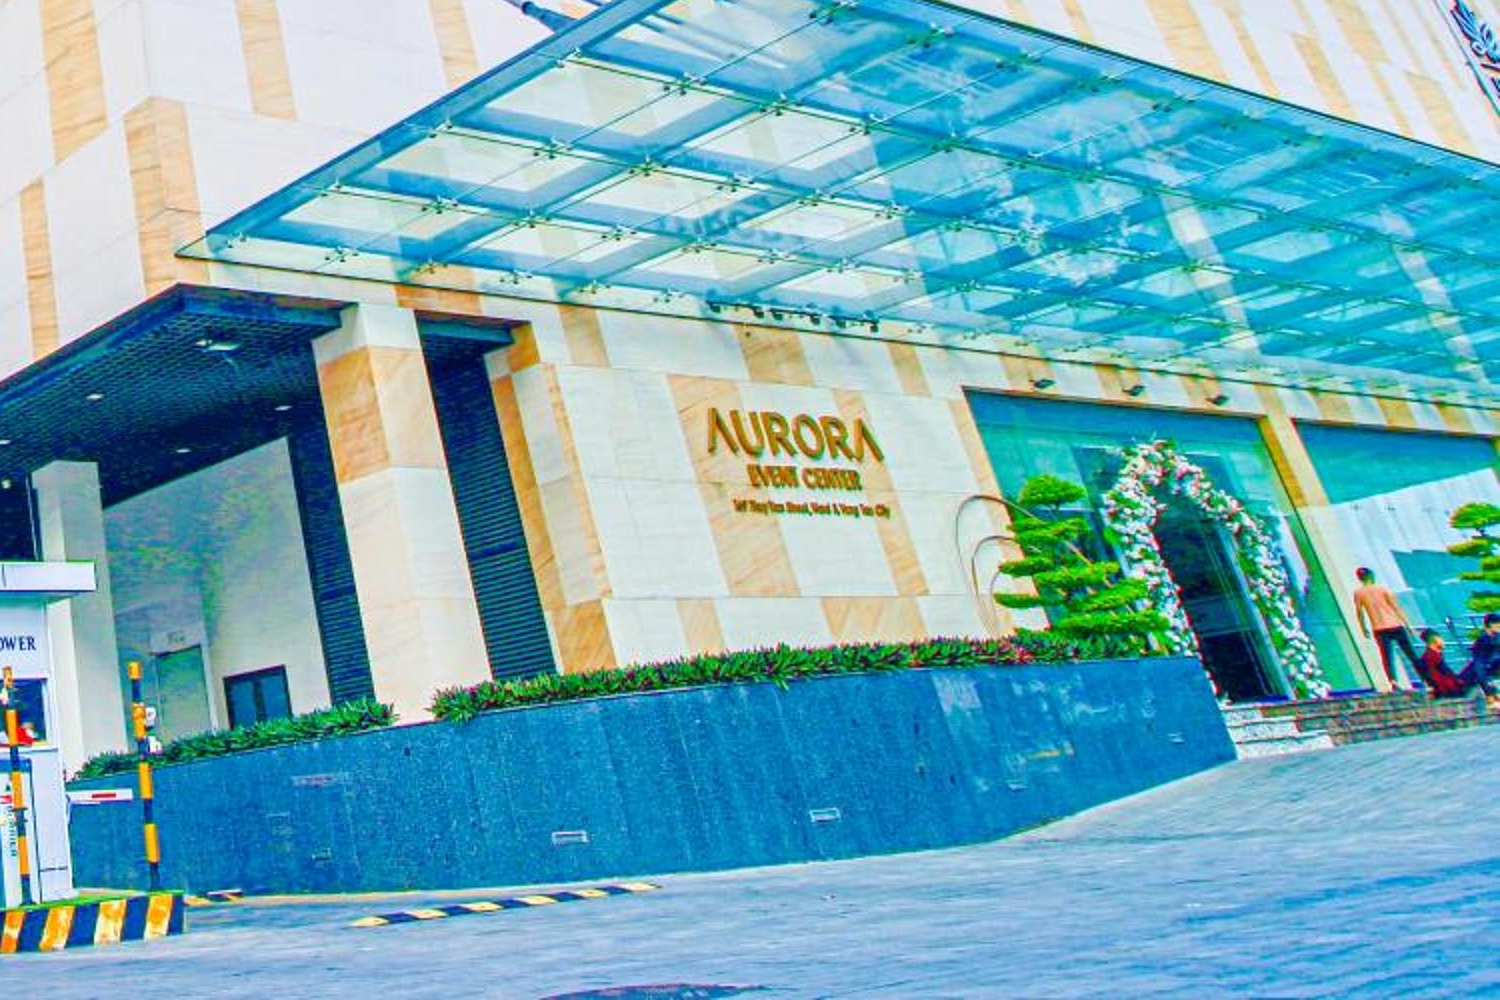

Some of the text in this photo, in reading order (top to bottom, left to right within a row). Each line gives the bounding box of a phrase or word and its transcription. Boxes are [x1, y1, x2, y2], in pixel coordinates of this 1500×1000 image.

[707, 407, 885, 463] AURORA
[747, 464, 863, 490] EVENT CENTER
